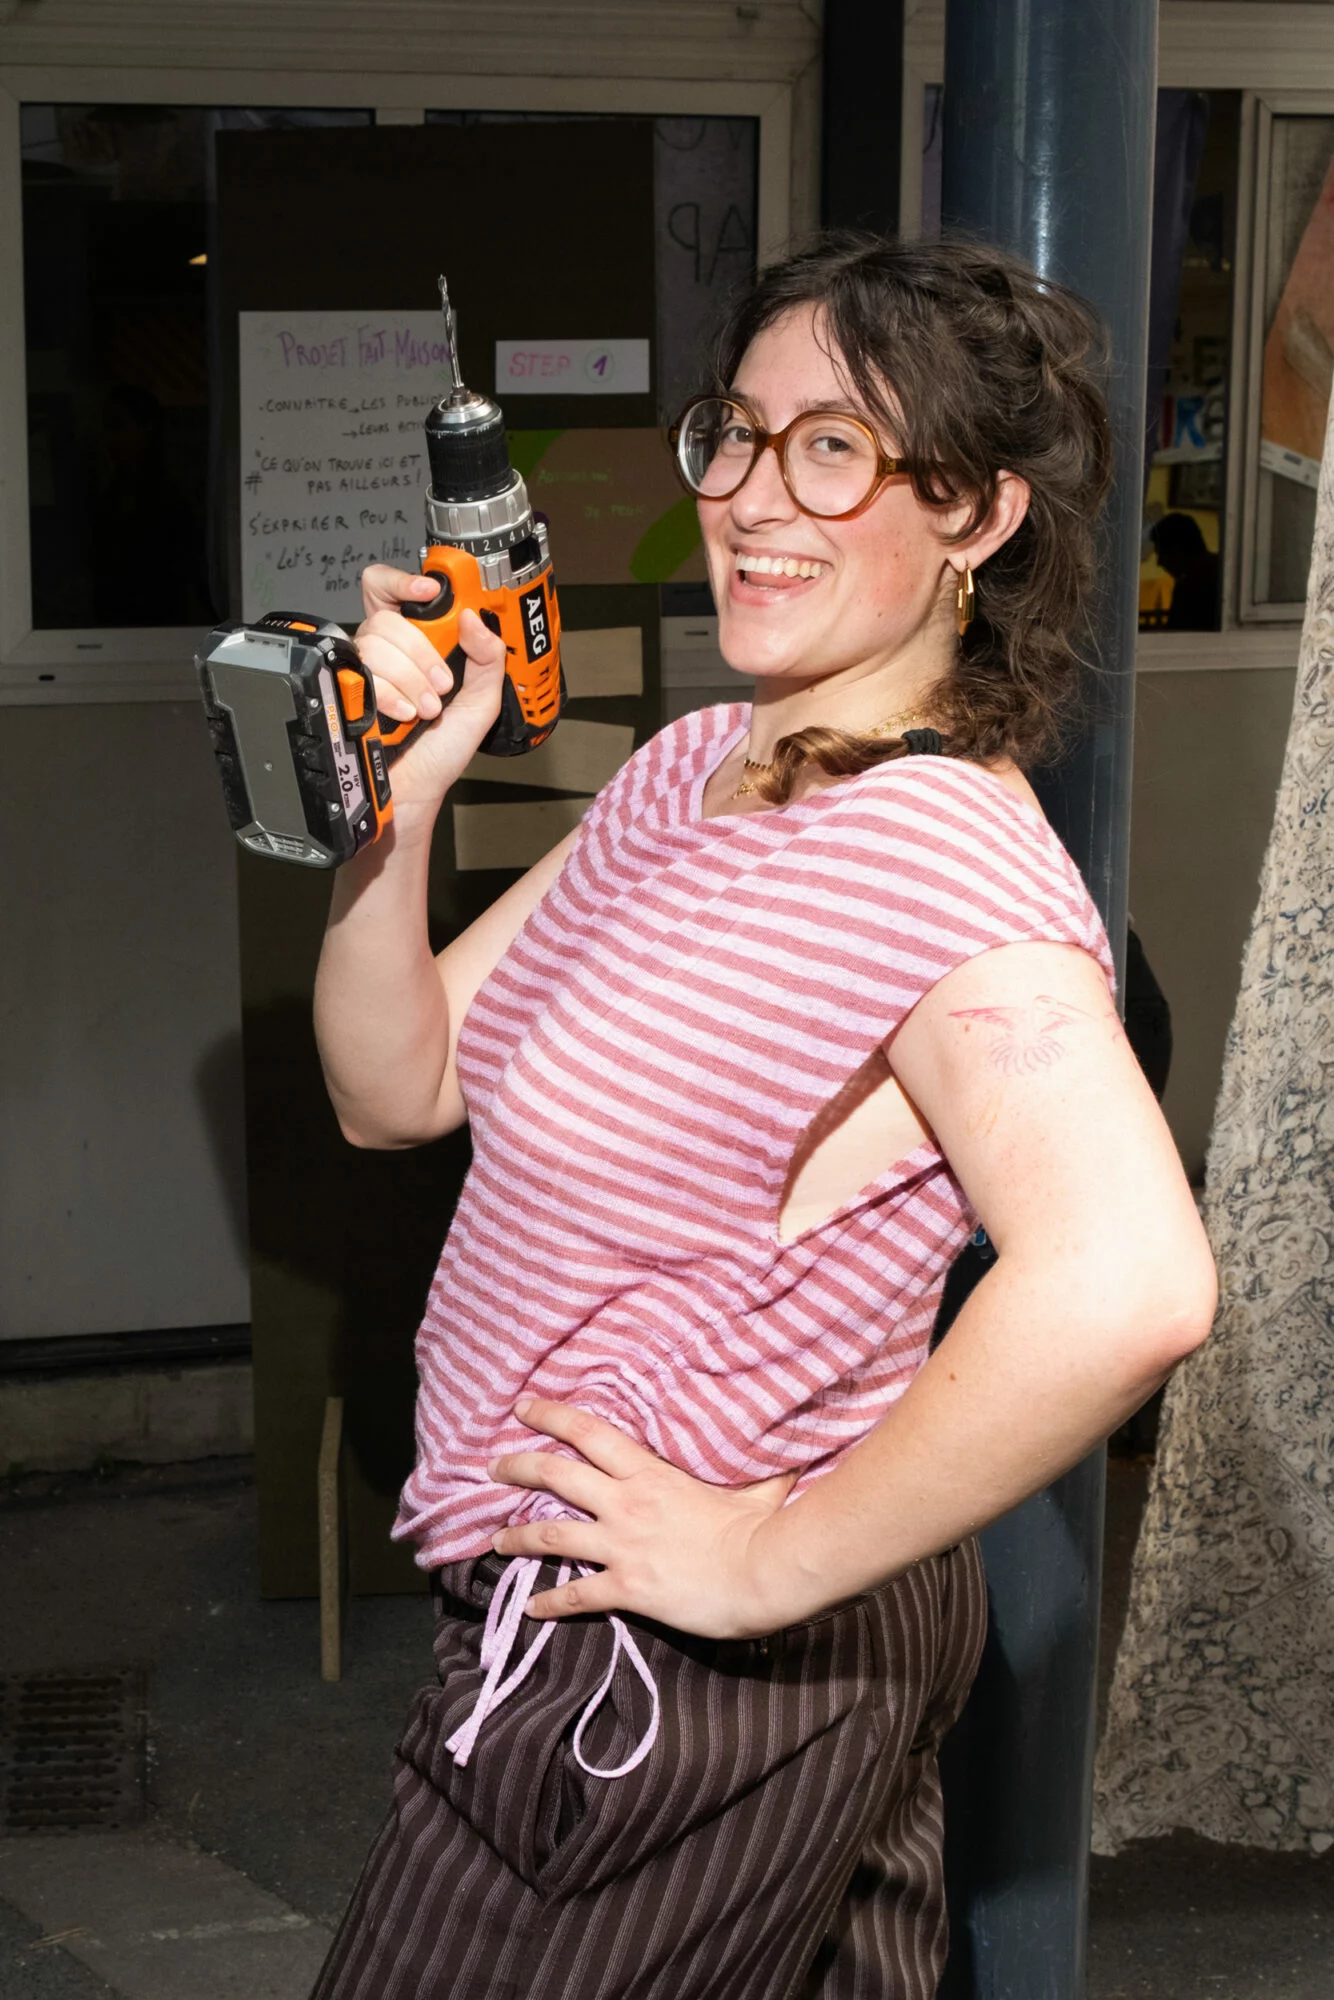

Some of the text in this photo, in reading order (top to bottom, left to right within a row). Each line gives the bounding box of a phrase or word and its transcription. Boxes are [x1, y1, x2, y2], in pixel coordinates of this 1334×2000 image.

[508, 351, 608, 378] STEP 1
[361, 397, 386, 410] LES
[328, 457, 372, 471] TROUVE
[400, 454, 421, 467] ET
[307, 480, 332, 495] PAS
[360, 509, 408, 528] POUR
[483, 540, 491, 552] 2
[509, 530, 516, 543] 4
[320, 554, 335, 575] go
[341, 544, 362, 567] for
[526, 596, 547, 656] AEG
[338, 764, 354, 793] 2.0
